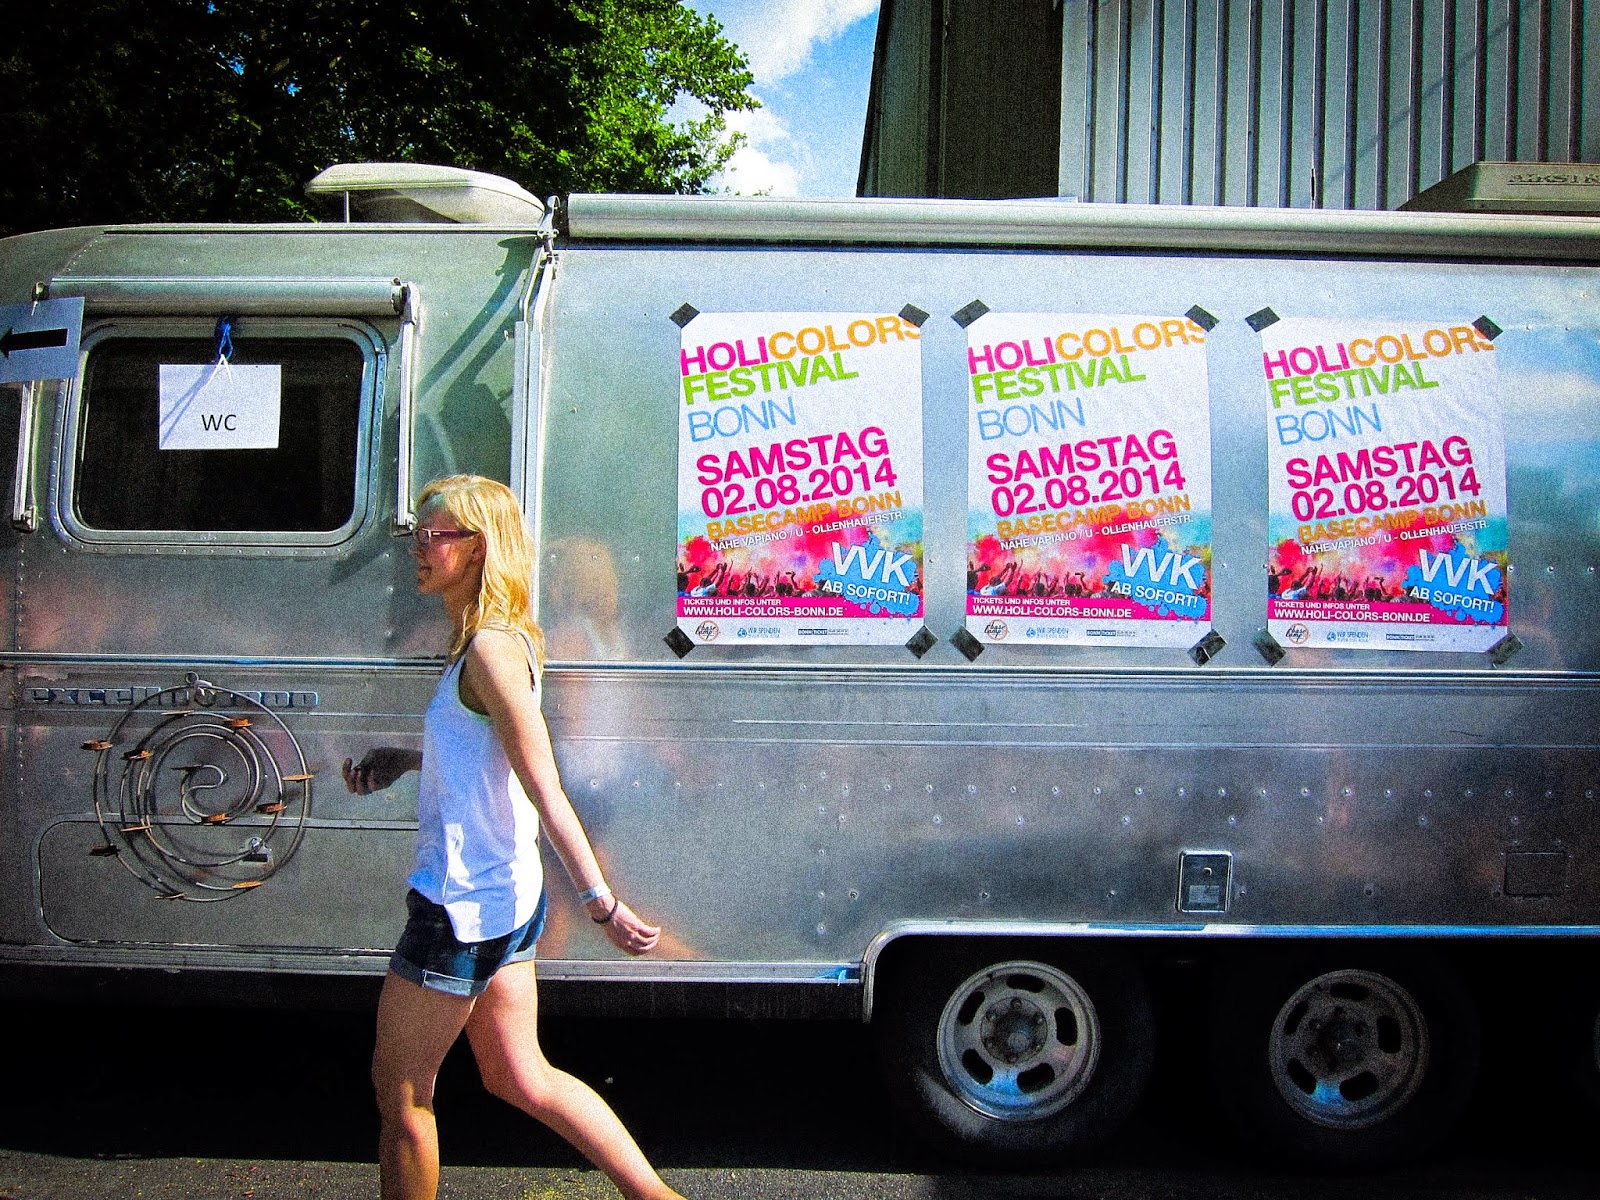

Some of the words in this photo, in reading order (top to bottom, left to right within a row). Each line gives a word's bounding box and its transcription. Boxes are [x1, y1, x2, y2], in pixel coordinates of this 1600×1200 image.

[683, 352, 859, 405] FESTIVAL
[971, 354, 1147, 403] FESTIVAL
[1268, 361, 1440, 408] FESTIVAL
[201, 414, 237, 431] WC
[687, 396, 797, 442] BONN
[977, 397, 1085, 441] BONN
[1275, 402, 1382, 446] BONN
[696, 426, 890, 486] SAMSTAG
[986, 429, 1178, 484] SAMSTAG
[1285, 435, 1473, 490] SAMSTAG
[701, 457, 897, 518] 02.08.2014
[991, 460, 1186, 517] 02.08.2014
[1291, 467, 1481, 522] 02.08.2014
[706, 503, 832, 540] BASECAMP
[837, 491, 903, 518] BONN
[741, 530, 787, 546] VAPIANO
[812, 511, 905, 535] OLLENHAUERSTR.
[997, 504, 1122, 539] BASECAMP
[1127, 493, 1191, 520] BONN
[1031, 532, 1077, 547] VAPIANO
[1101, 514, 1194, 536] OLLENHAUERSTR.
[1297, 508, 1419, 543] BASECAMP
[1422, 499, 1487, 526] BONN
[1330, 535, 1376, 551] VAPIANO
[1400, 520, 1489, 541] OLLENHAUERSTR.
[831, 541, 914, 587] VVK
[1121, 543, 1202, 590] VVK
[1419, 548, 1498, 595] VVK
[683, 598, 714, 606] TICKETS
[715, 598, 732, 606] UND
[683, 606, 844, 617] WWW.HOLI-COLORS-BONN.DE
[821, 579, 843, 594] AB
[846, 583, 911, 605] SOFORT!
[972, 606, 1132, 618] WWW.HOLI-COLORS-BONN.DE
[973, 597, 1004, 605] TICKETS
[1021, 598, 1045, 606] INFOS
[1045, 598, 1071, 606] UNTER
[1110, 580, 1132, 596] AB
[1134, 584, 1198, 608] SOFORT!
[1322, 602, 1345, 610] INFOS
[1345, 602, 1370, 610] UNTER
[1409, 585, 1430, 600] AB
[1433, 588, 1495, 613] SOFORT!
[1274, 610, 1430, 622] WWW.HOLI-COLORS-BONN.DE
